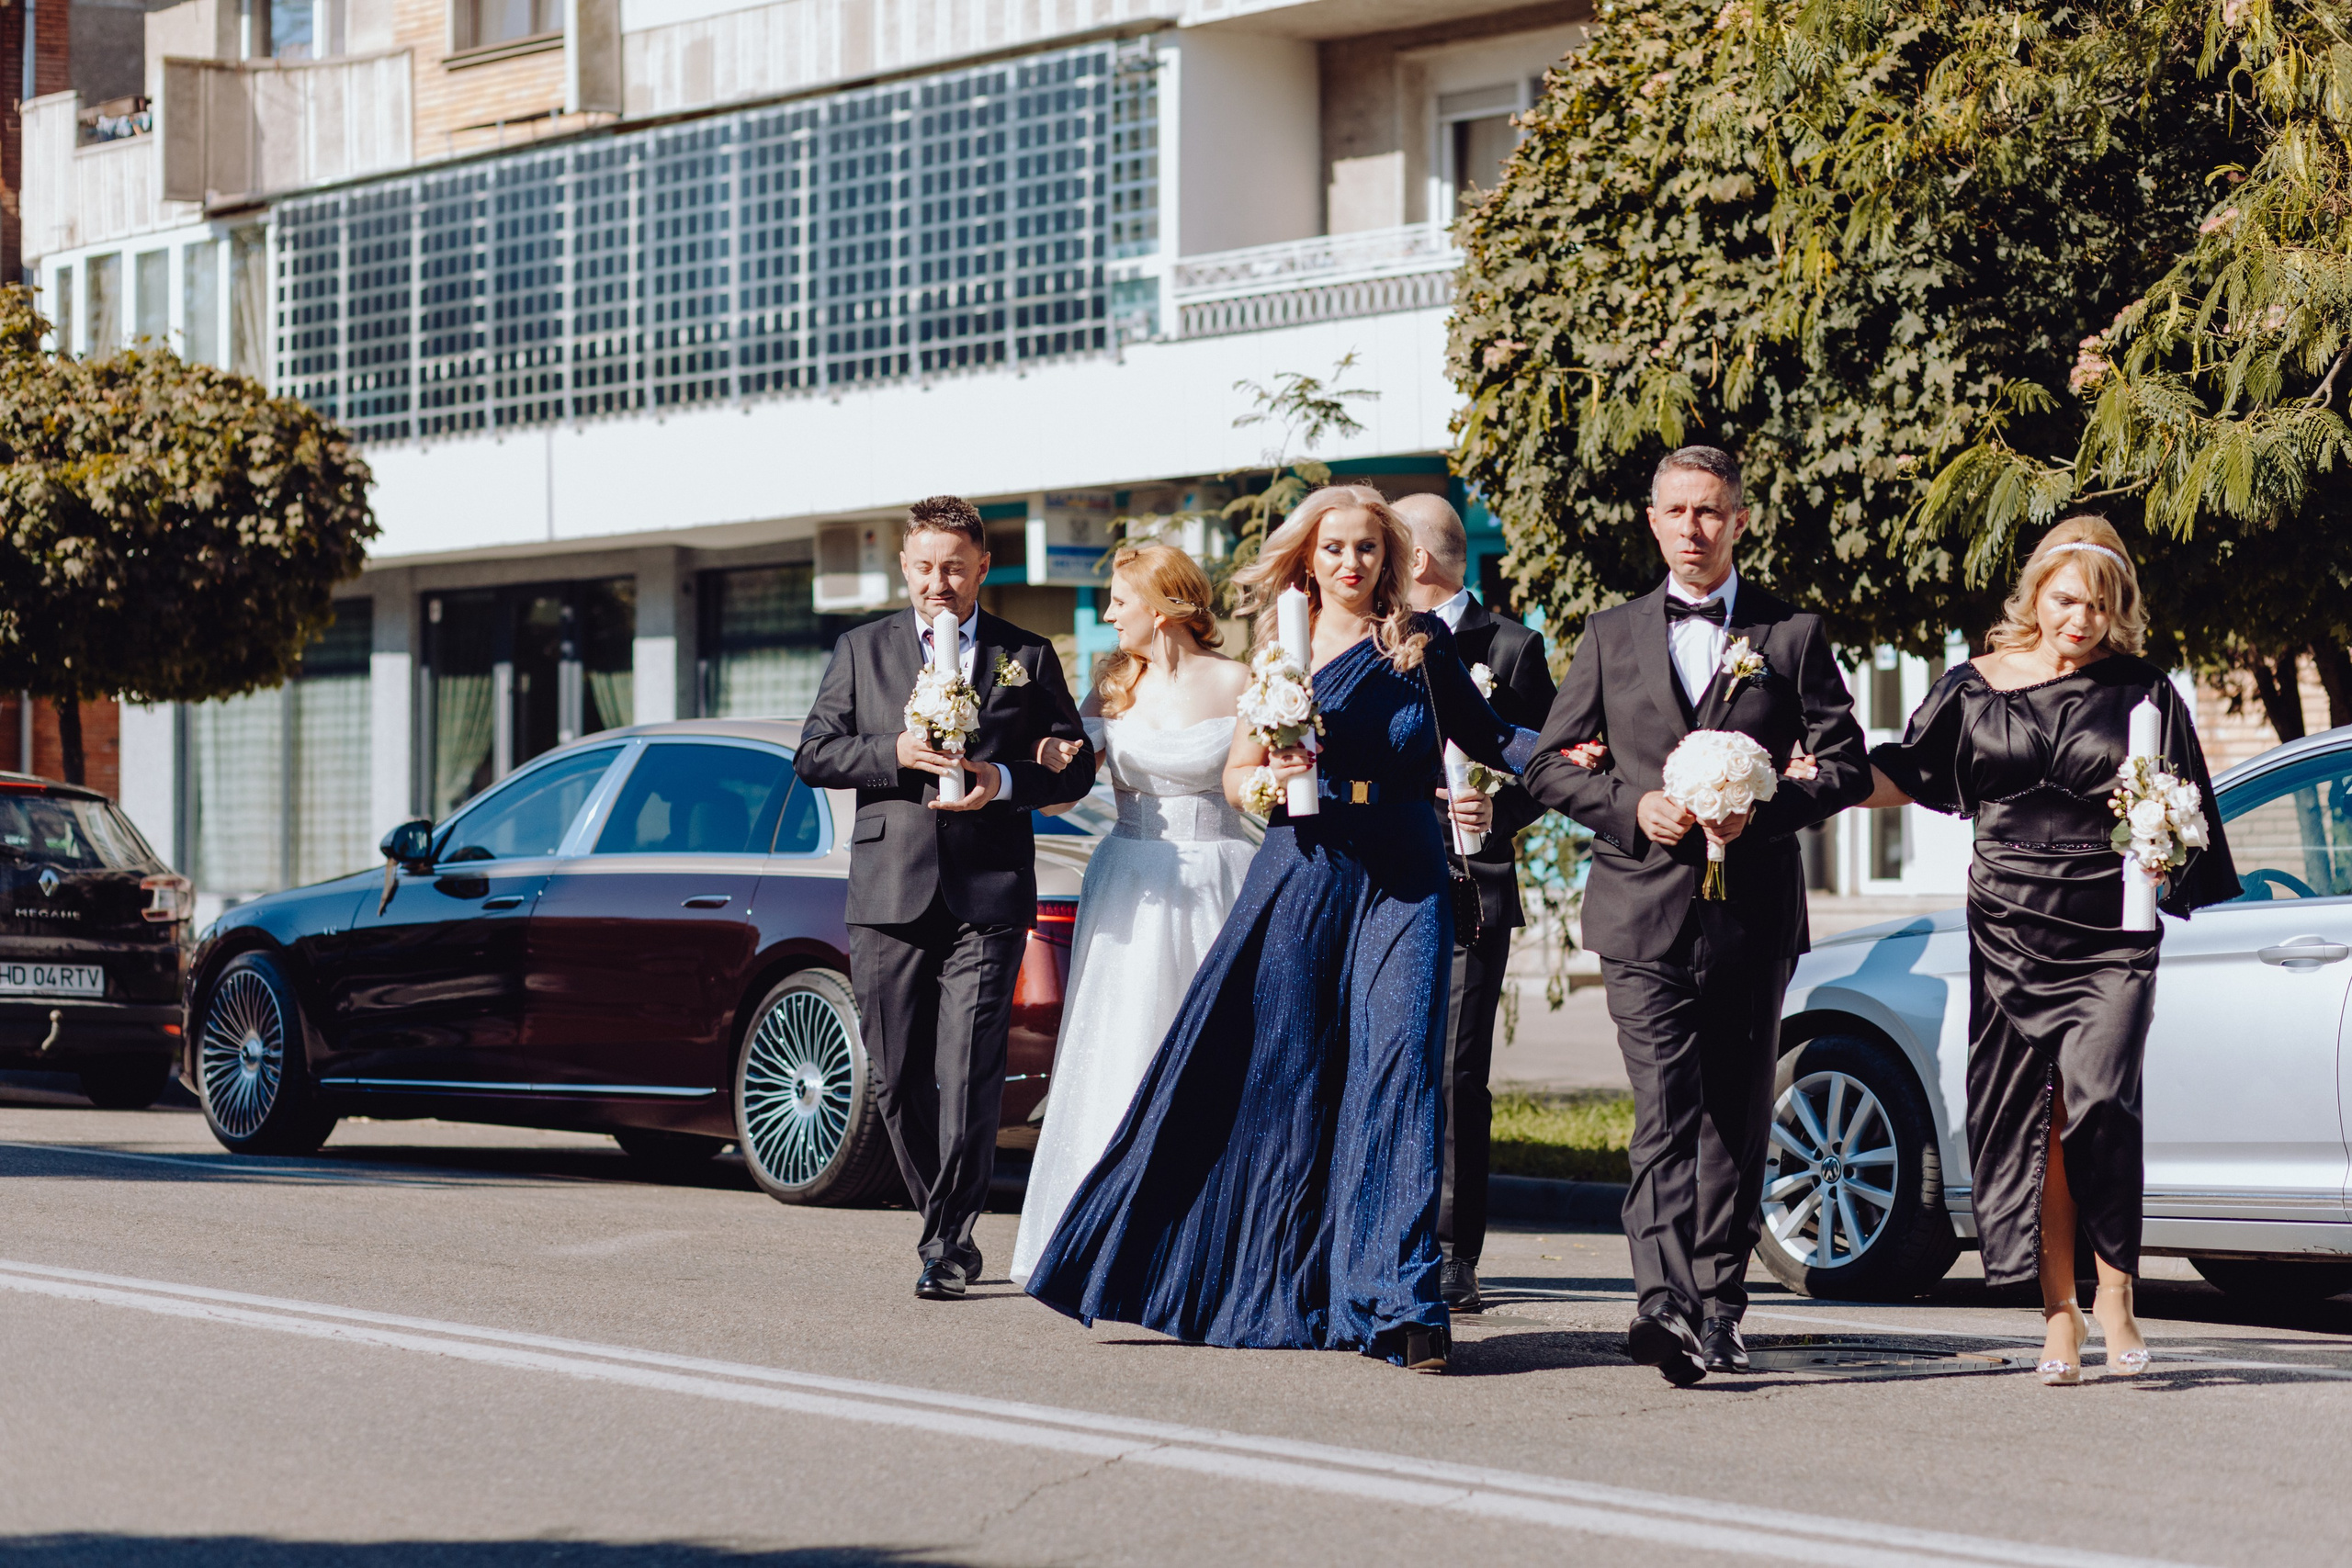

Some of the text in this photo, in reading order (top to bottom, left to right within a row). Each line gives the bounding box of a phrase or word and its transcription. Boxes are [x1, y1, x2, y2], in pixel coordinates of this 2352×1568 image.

[0, 965, 99, 987] HD 04 RTV
